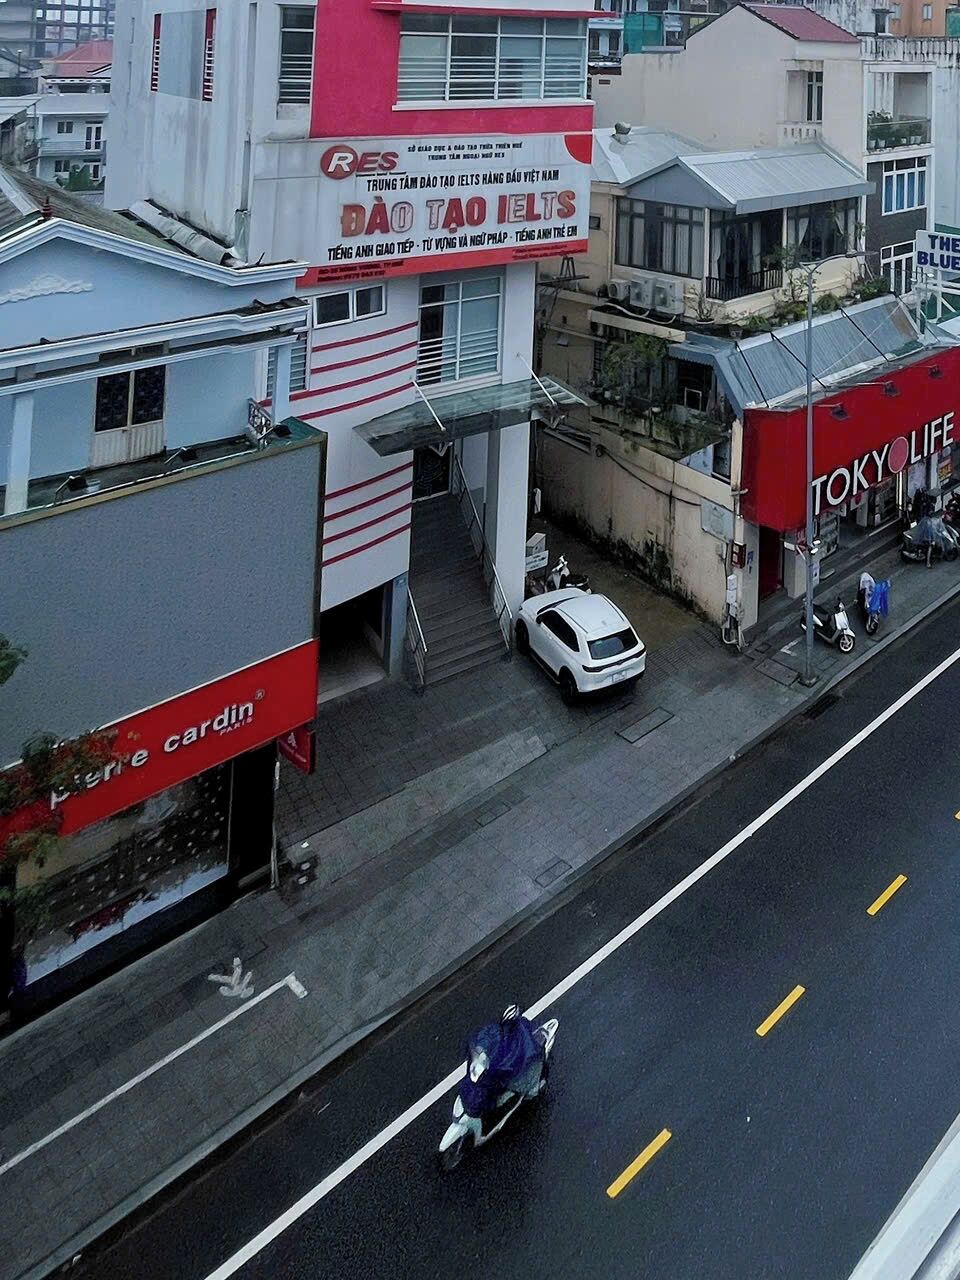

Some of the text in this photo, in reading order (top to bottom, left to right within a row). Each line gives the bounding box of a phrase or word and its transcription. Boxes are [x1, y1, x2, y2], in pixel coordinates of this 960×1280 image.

[327, 151, 399, 173] RES
[366, 178, 397, 192] TRUNG
[399, 174, 418, 190] TÂM
[440, 175, 455, 190] TẠO
[457, 173, 480, 187] IELTS
[482, 170, 504, 185] HÀNG
[523, 169, 540, 184] VIỆT
[541, 169, 560, 181] NAM
[340, 189, 577, 238] ĐÀO TẠO IELTS
[327, 243, 353, 261] TIẾNG
[355, 244, 374, 259] ANH
[375, 241, 395, 256] GIAO
[396, 237, 415, 254] TIẾP
[435, 234, 456, 252] VỰNG
[458, 233, 468, 248] VÀ
[469, 232, 486, 246] NGỮ
[487, 230, 508, 245] PHÁP
[515, 228, 536, 243] TIẾNG
[537, 228, 552, 240] ANH
[566, 225, 578, 237] EM
[163, 702, 254, 753] cardin
[219, 716, 253, 736] PARIS
